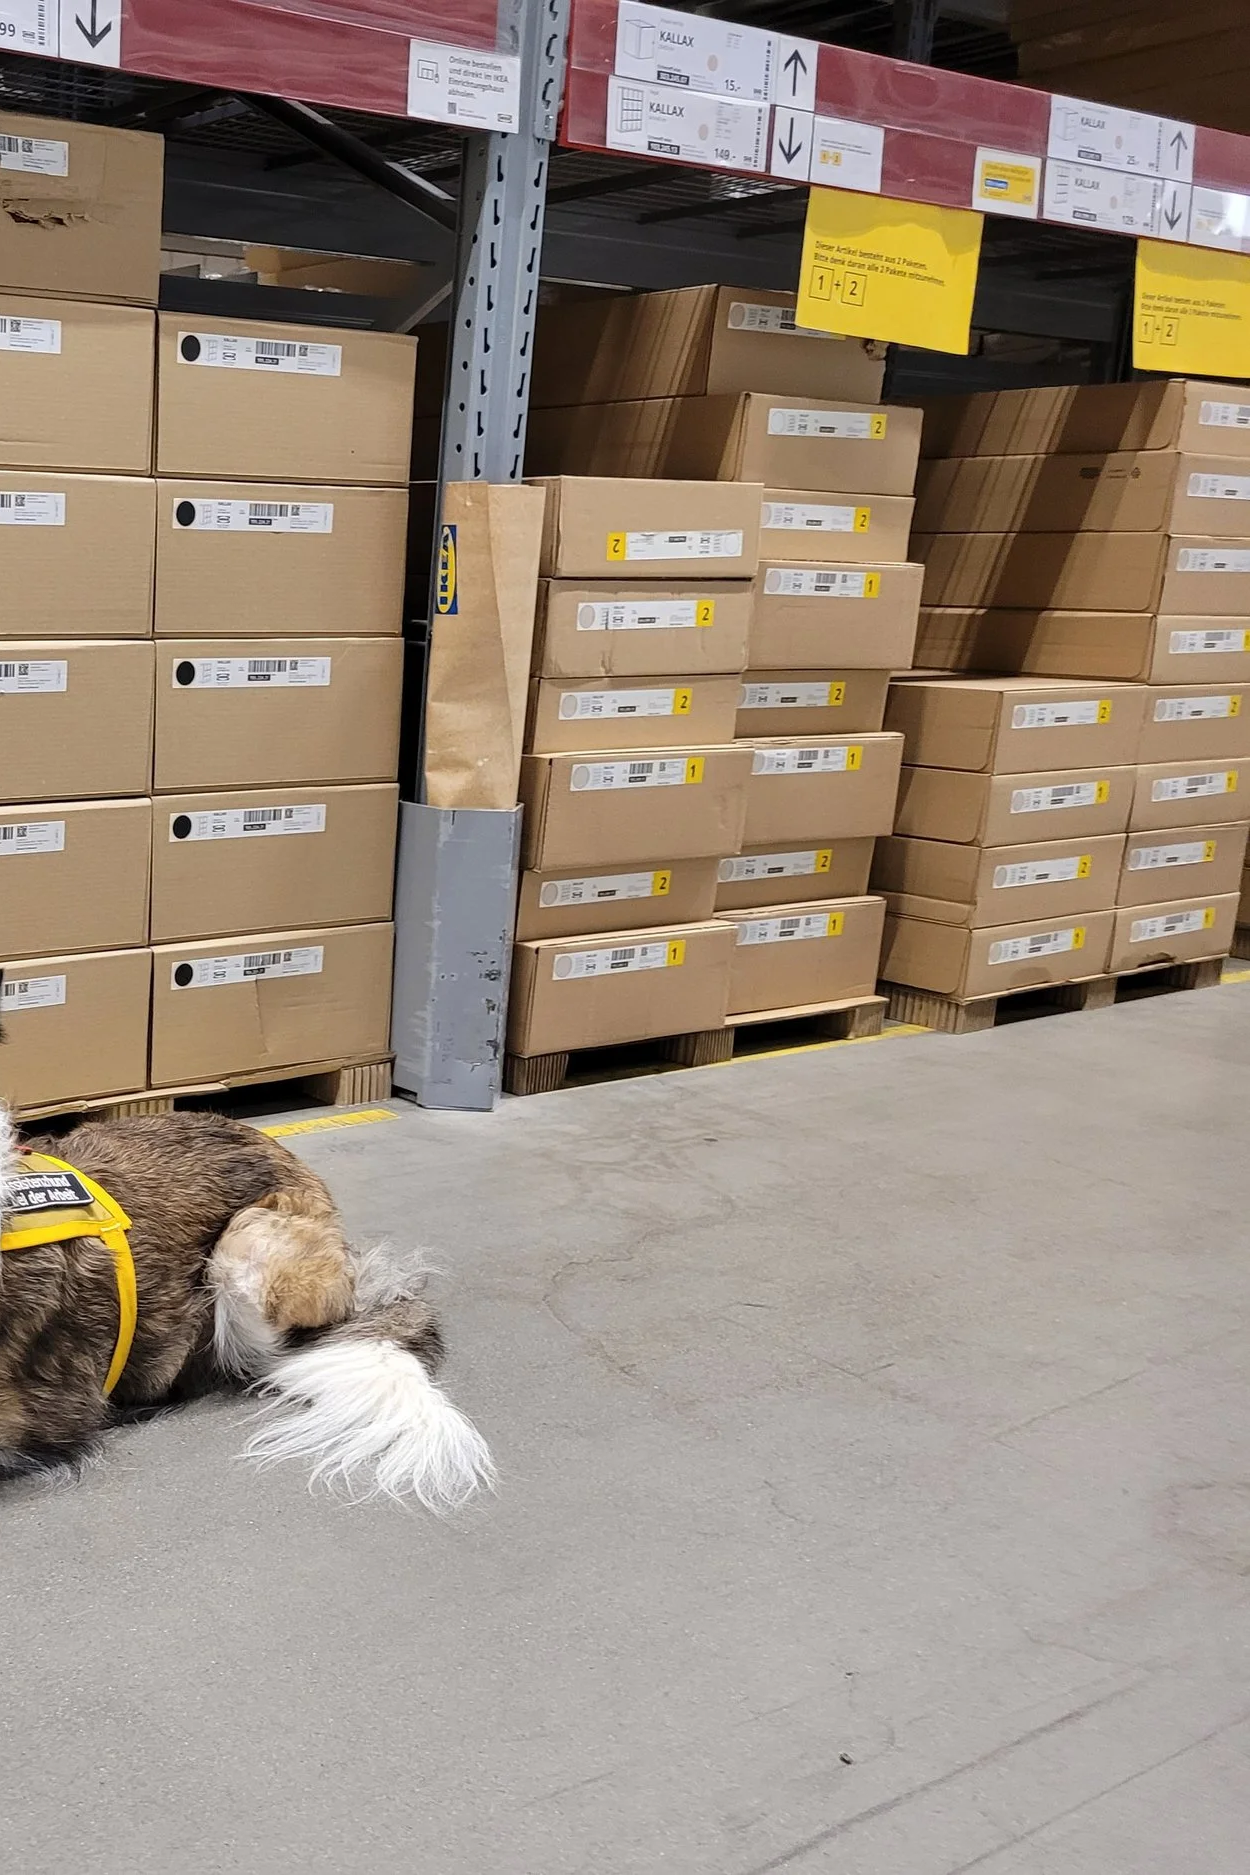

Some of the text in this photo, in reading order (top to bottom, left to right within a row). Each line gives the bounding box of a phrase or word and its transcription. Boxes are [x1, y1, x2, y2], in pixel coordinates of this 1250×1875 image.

[659, 30, 695, 48] KALLAX
[449, 55, 502, 72] Online bestellen
[449, 68, 461, 76] und
[463, 69, 482, 79] direkt
[493, 74, 509, 83] IKEA
[448, 77, 505, 93] Einrichtungshaus
[649, 101, 684, 118] KALLAX
[815, 240, 835, 252] Dieser
[837, 244, 857, 257] Artikel
[859, 249, 883, 262] besteht
[885, 256, 896, 264] aus
[814, 252, 828, 263] Bitte
[830, 256, 845, 266] denk
[847, 259, 866, 270] daran
[867, 263, 879, 272] alle
[885, 266, 907, 277] Pakete
[818, 275, 824, 290] 1
[849, 281, 858, 296] 2
[1144, 321, 1148, 335] 1
[1166, 323, 1173, 337] 2
[875, 421, 882, 434] 2
[860, 514, 867, 527] 2
[612, 539, 620, 553] 2
[868, 580, 873, 593] 1
[702, 607, 710, 620] 2
[835, 688, 842, 701] 2
[680, 695, 688, 709] 2
[1100, 706, 1107, 719] 2
[850, 753, 855, 765] 1
[690, 764, 696, 778] 1
[821, 855, 828, 868] 2
[1081, 862, 1087, 874] 2
[659, 877, 667, 890] 2
[831, 918, 837, 931] 1
[670, 948, 677, 960] 1
[28, 1190, 46, 1204] der
[47, 1185, 80, 1201] Arbeit
